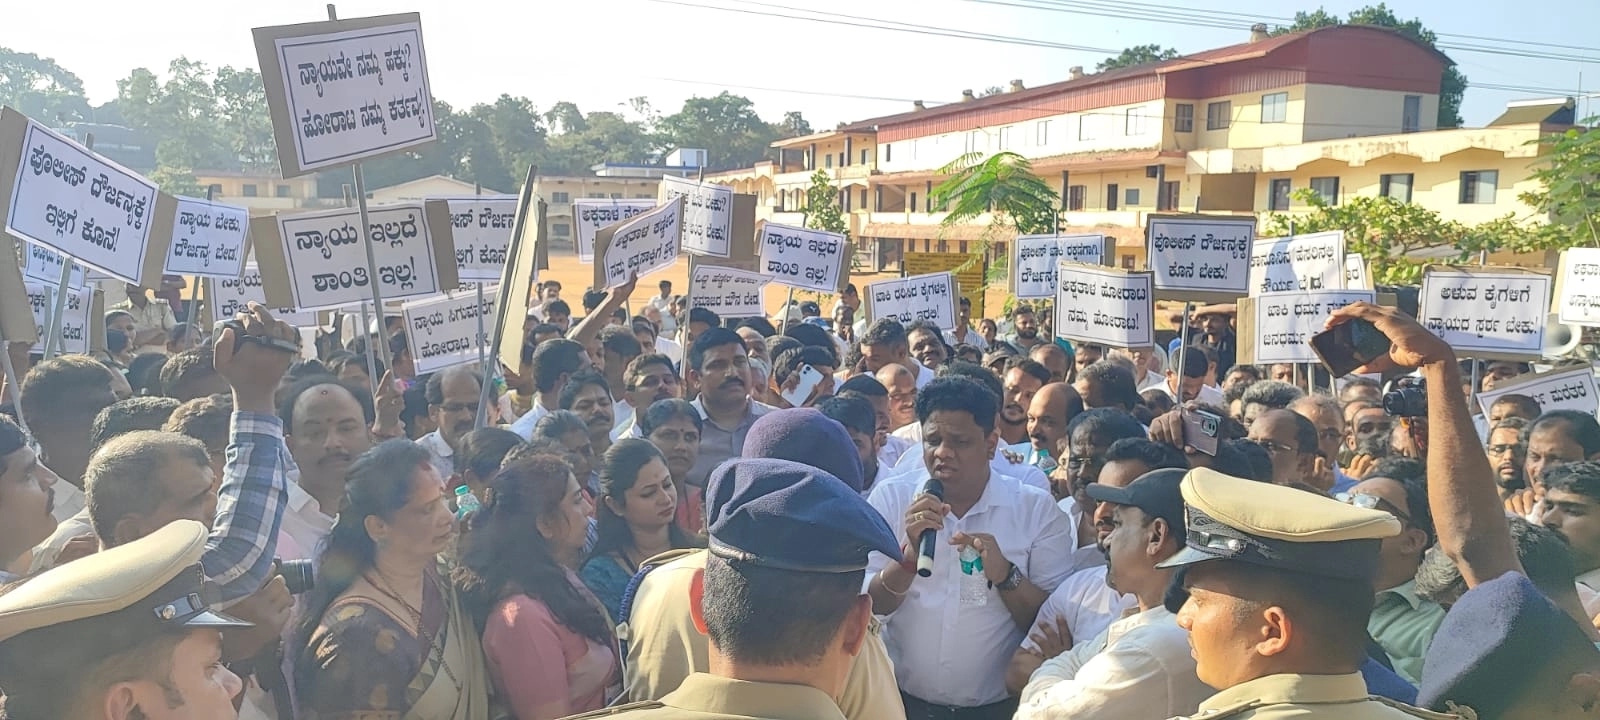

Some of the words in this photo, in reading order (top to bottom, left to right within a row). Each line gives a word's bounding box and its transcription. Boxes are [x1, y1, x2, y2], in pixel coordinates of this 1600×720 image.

[298, 51, 353, 97] ನ್ಯಾಯವೇ
[356, 49, 384, 86] ನಮ್ಮ
[384, 43, 411, 82] ಹಕ್ಕು?
[302, 106, 356, 138] ಹೋರಾಟ
[359, 100, 387, 135] ನಮ್ಮ
[388, 88, 425, 128] ಕರ್ತವ್ಯ!
[30, 144, 87, 187] ಪೊಲೀಸ್
[90, 173, 147, 230] ದೌರ್ಜನ್ಯಕ್ಕೆ
[45, 203, 78, 238] ಇಲ್ಲಿಗೆ
[81, 217, 121, 252] ಕೊನೆ!
[180, 211, 211, 235] ನ್ಯಾಯ
[295, 220, 358, 259] ನ್ಯಾಯ
[369, 213, 418, 247] ಇಲ್ಲದೆ
[767, 232, 802, 255] ನ್ಯಾಯ
[808, 239, 838, 259] ಇಲ್ಲದೆ
[1155, 233, 1197, 252] ಪೊಲೀಸ್
[1200, 233, 1248, 259] ದೌರ್ಜನ್ಯಕ್ಕೆ
[174, 238, 211, 267] ದೌರ್ಜನ್ಯ
[215, 243, 239, 261] ಬೇಡ!
[312, 267, 369, 292] ಶಾಂತಿ
[379, 256, 418, 290] ಇಲ್ಲ!
[610, 259, 626, 280] ನಮ್ಮ
[767, 259, 799, 276] ಶಾಂತಿ
[805, 265, 829, 286] ಇಲ್ಲ!
[1168, 262, 1194, 279] ಕೊನೆ
[1199, 262, 1229, 280] ಬೇಕು!
[1062, 278, 1097, 300] ಅಕ್ಷತಾಳ
[1101, 281, 1147, 301] ಹೋರಾಟ
[1441, 284, 1478, 301] ಅಳುವ
[1485, 284, 1530, 309] ಕೈಗಳಿಗೆ
[414, 310, 444, 335] ನ್ಯಾಯ
[1068, 308, 1089, 331] ನಮ್ಮ
[1094, 310, 1139, 331] ಹೋರಾಟ!
[1428, 315, 1470, 338] ನ್ಯಾಯದ
[1506, 316, 1538, 334] ಬೇಕು!
[421, 335, 470, 358] ಹೋರಾಟ
[1549, 381, 1587, 402] ಮರೆತರೆ
